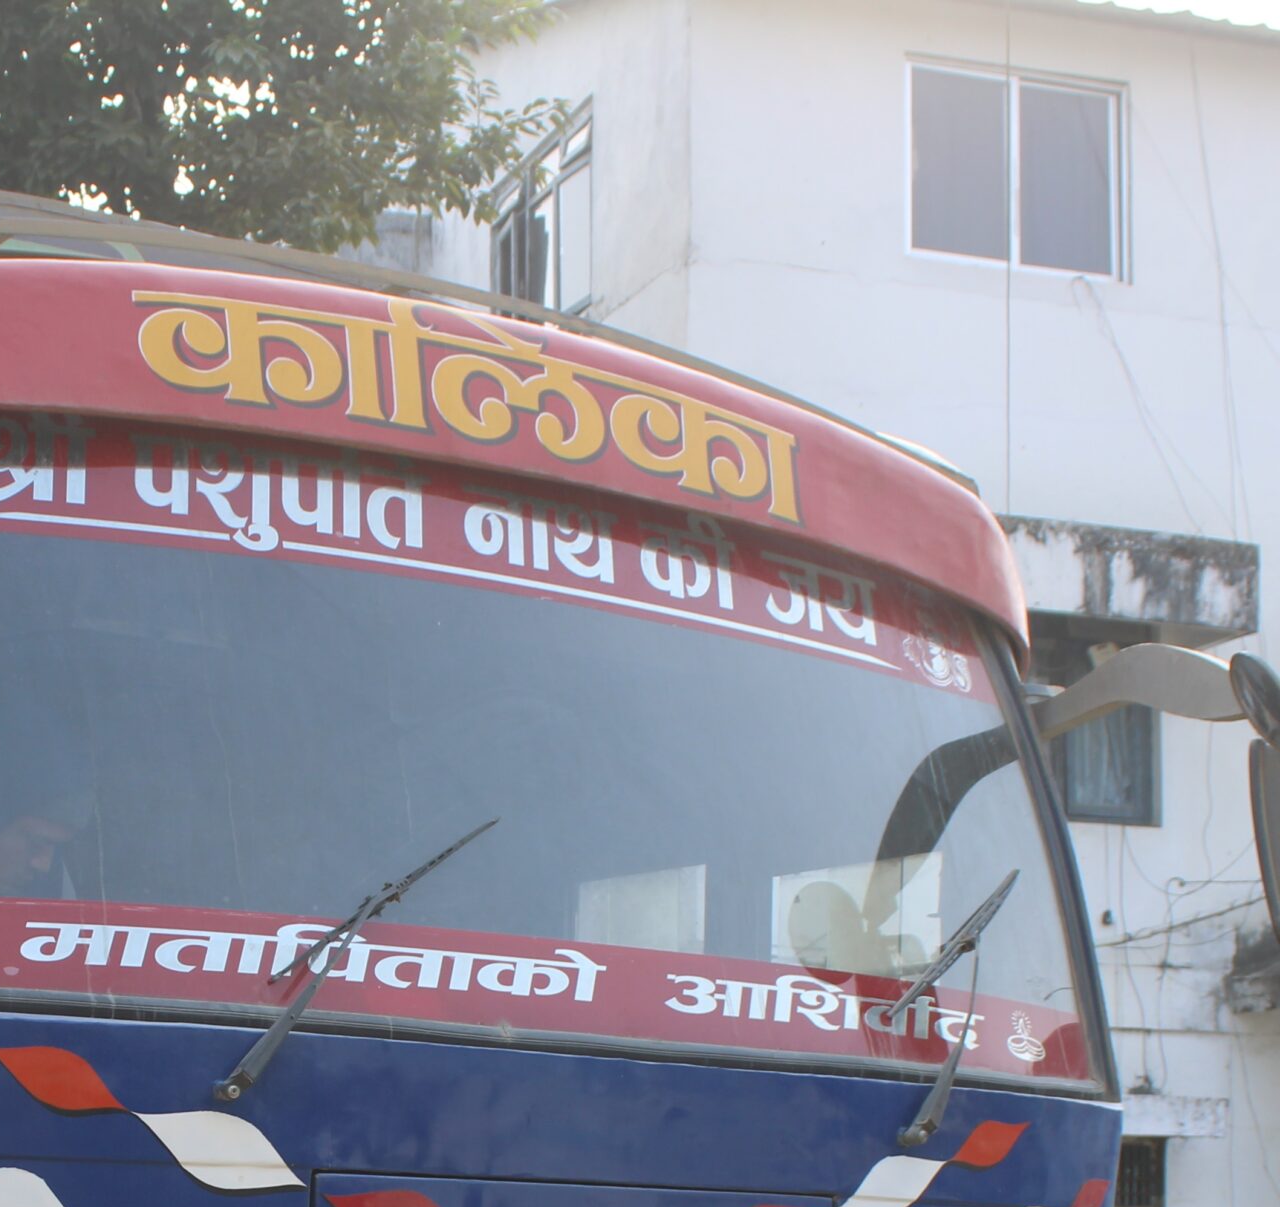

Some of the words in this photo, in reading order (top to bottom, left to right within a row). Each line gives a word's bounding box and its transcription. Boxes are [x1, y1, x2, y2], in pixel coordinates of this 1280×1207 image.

[131, 291, 804, 525] कालिका
[462, 484, 619, 584] नाथ
[760, 550, 878, 646] जय
[19, 921, 607, 1002] मातापिताको
